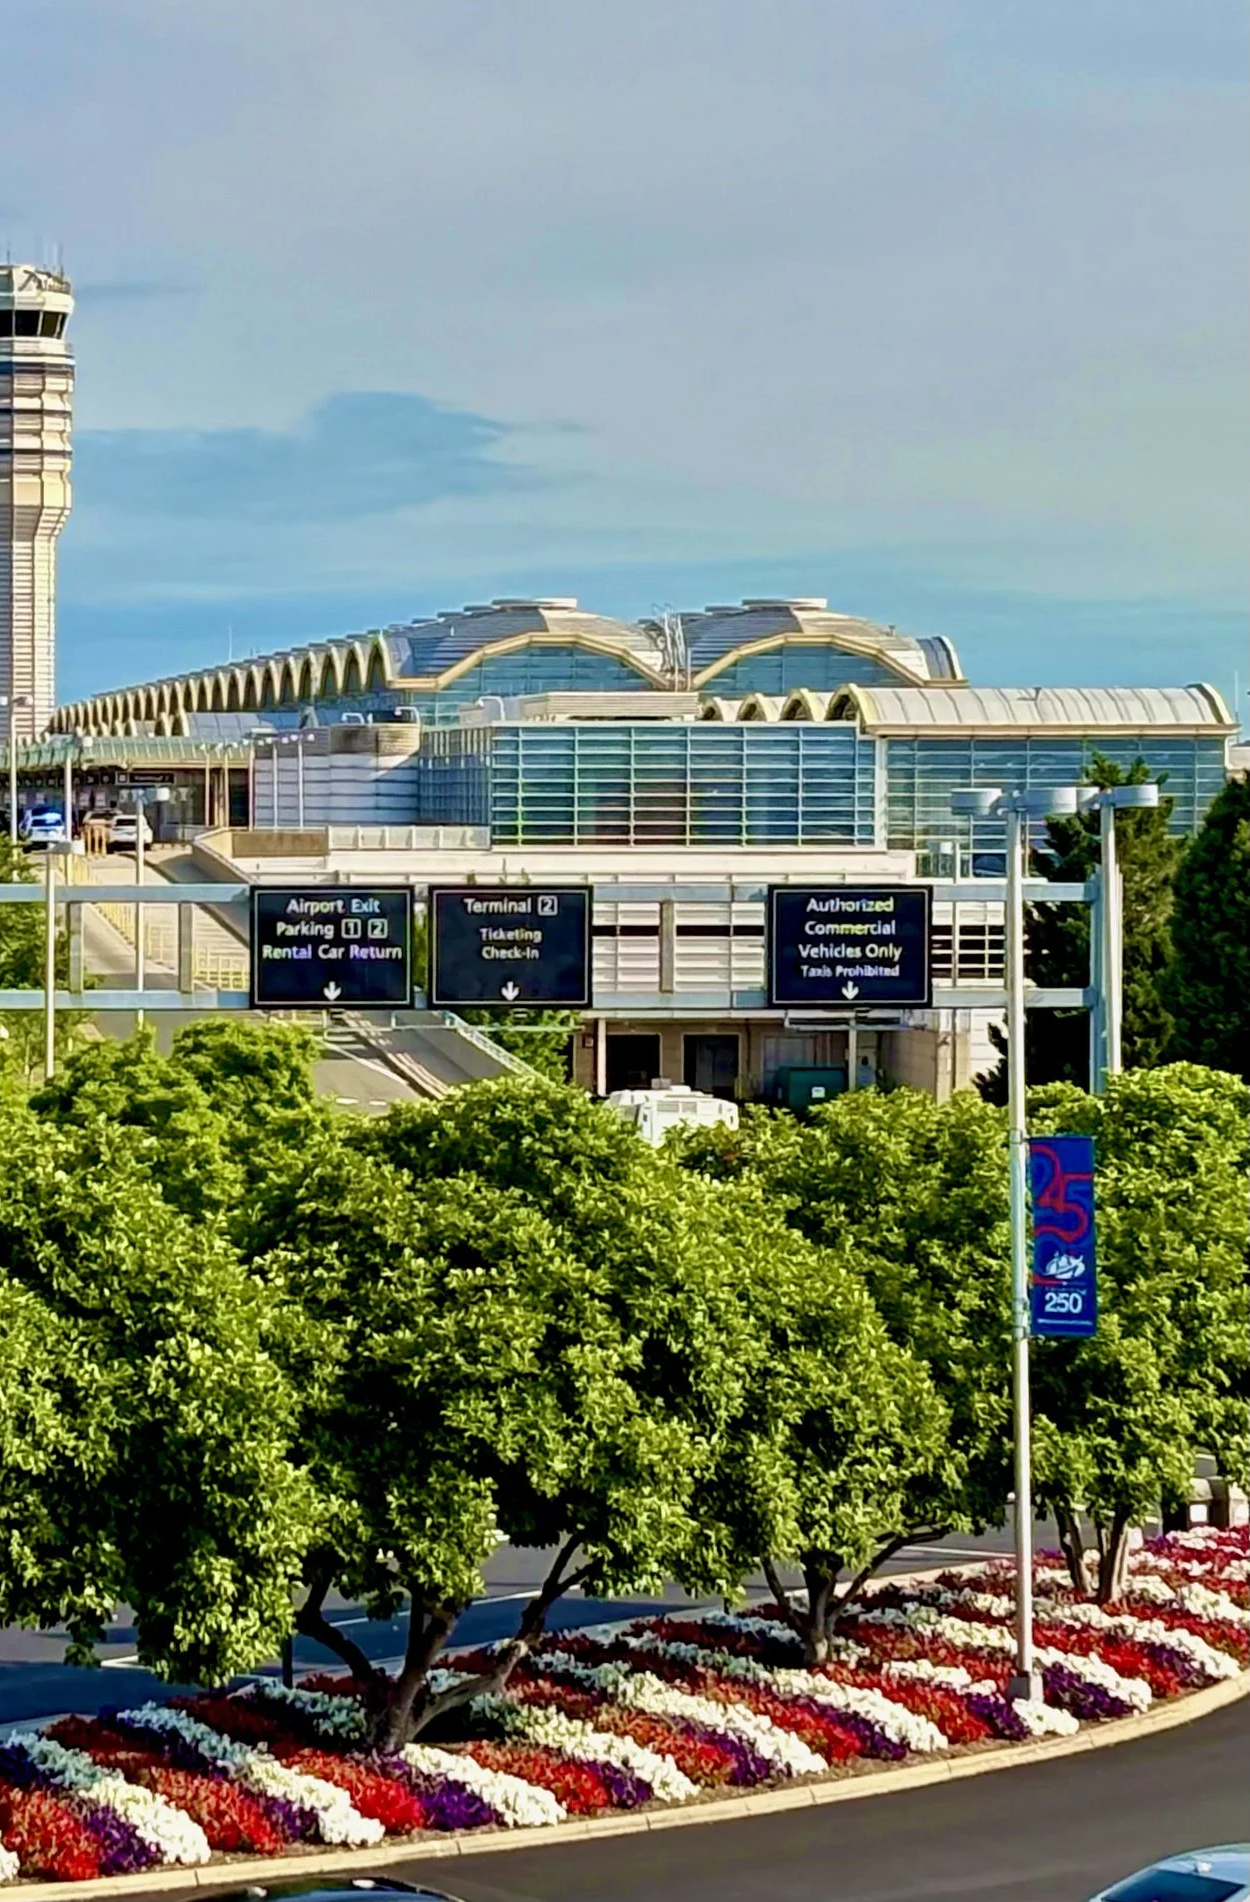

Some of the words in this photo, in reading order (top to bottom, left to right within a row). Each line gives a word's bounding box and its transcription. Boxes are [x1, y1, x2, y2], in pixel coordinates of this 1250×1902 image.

[286, 898, 343, 916] Airport
[351, 898, 381, 914] Exit
[464, 897, 531, 915] Terminal
[806, 897, 894, 912] Authorized
[277, 921, 334, 939] Parking
[804, 920, 896, 935] Commercial
[479, 928, 542, 944] Ticketing
[262, 945, 311, 959] Rental
[318, 945, 345, 959] Car
[349, 945, 402, 959] Return
[482, 946, 539, 960] Check-In
[799, 944, 862, 958] Vehicles
[865, 944, 902, 962] Only
[801, 965, 832, 978] Taxis
[836, 965, 900, 978] Prohibited
[1044, 1292, 1083, 1314] 250
